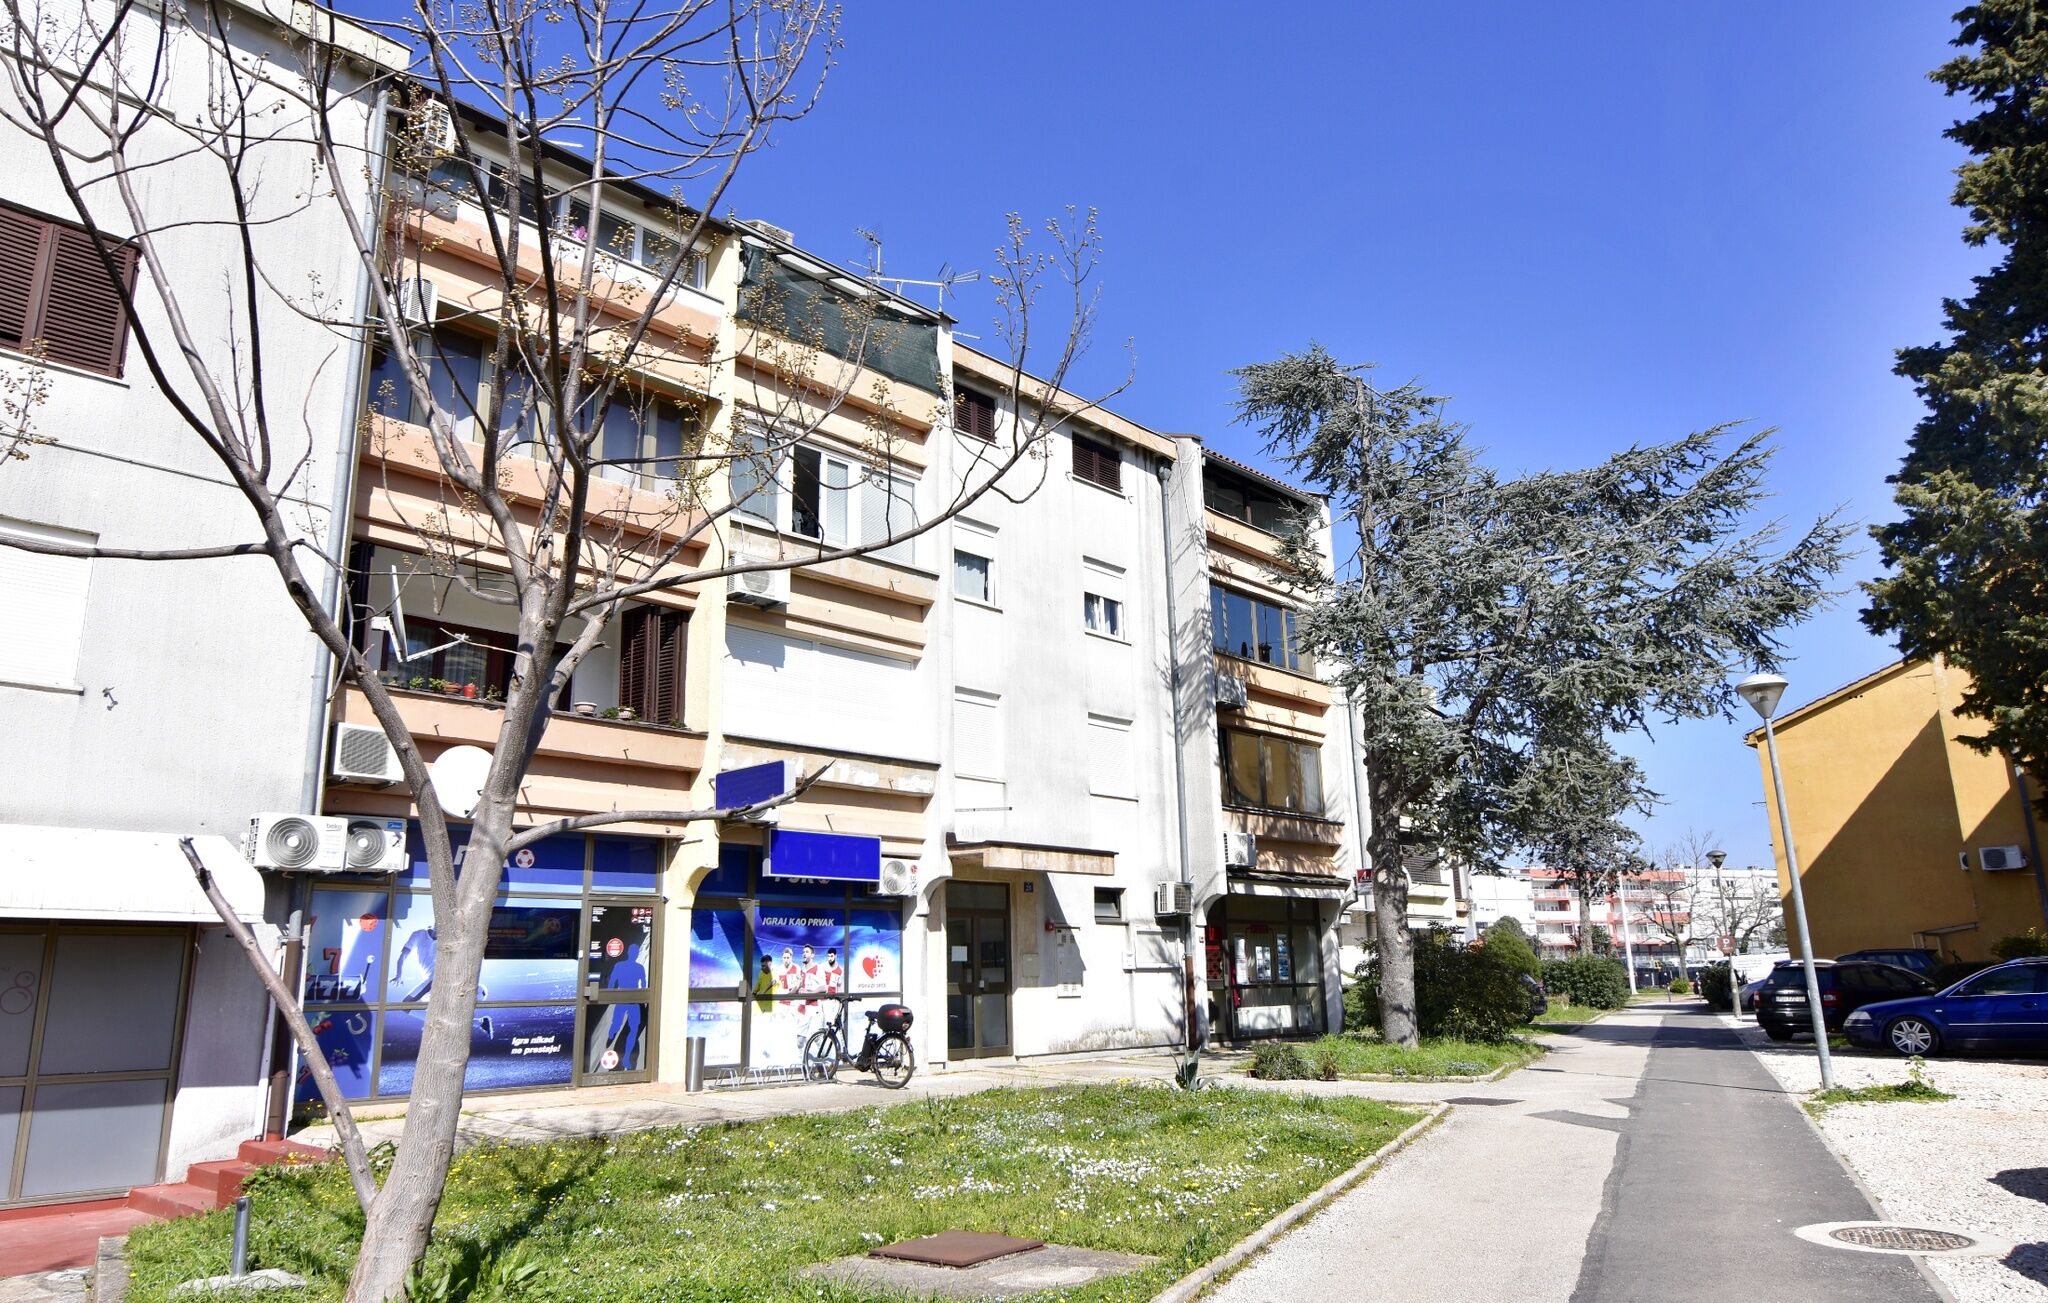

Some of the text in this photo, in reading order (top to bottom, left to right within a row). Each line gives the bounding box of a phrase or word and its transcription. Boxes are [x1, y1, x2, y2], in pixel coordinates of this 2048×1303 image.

[326, 823, 342, 831] beko
[762, 917, 835, 927] IGRAJ KAO PRVAK
[323, 947, 342, 975] 7
[511, 1035, 556, 1047] Igra nikad
